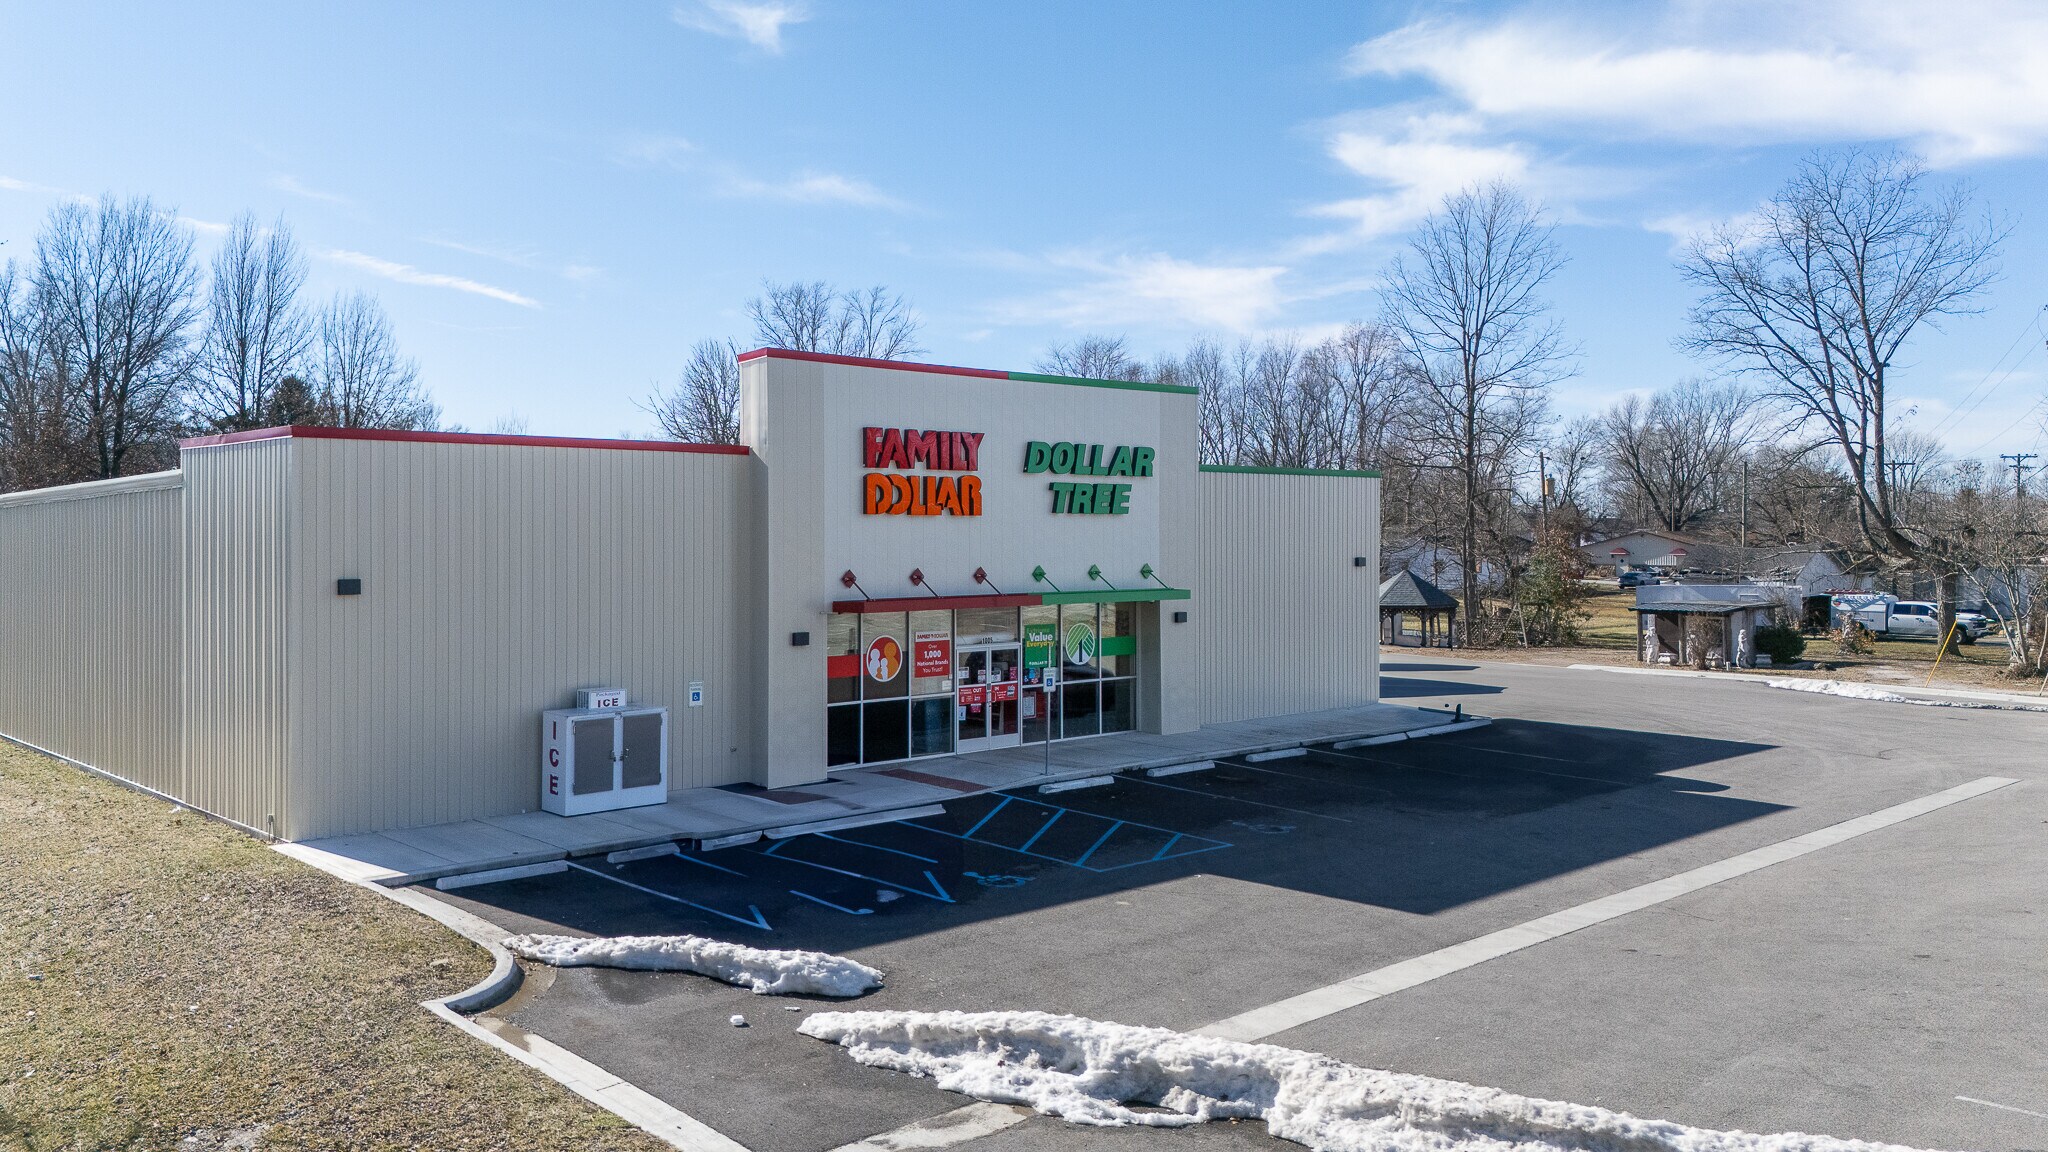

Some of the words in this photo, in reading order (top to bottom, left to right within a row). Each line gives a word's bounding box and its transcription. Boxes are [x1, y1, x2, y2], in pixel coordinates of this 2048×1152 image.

[863, 427, 985, 471] FAMILY
[1023, 441, 1156, 477] DOLLAR
[863, 472, 982, 516] DOLLAR
[1049, 482, 1132, 514] TREE
[1026, 640, 1055, 648] Everyday
[1029, 632, 1053, 642] Value
[924, 650, 942, 659] 1,000
[598, 697, 619, 708] ICE
[549, 720, 559, 796] ICE
